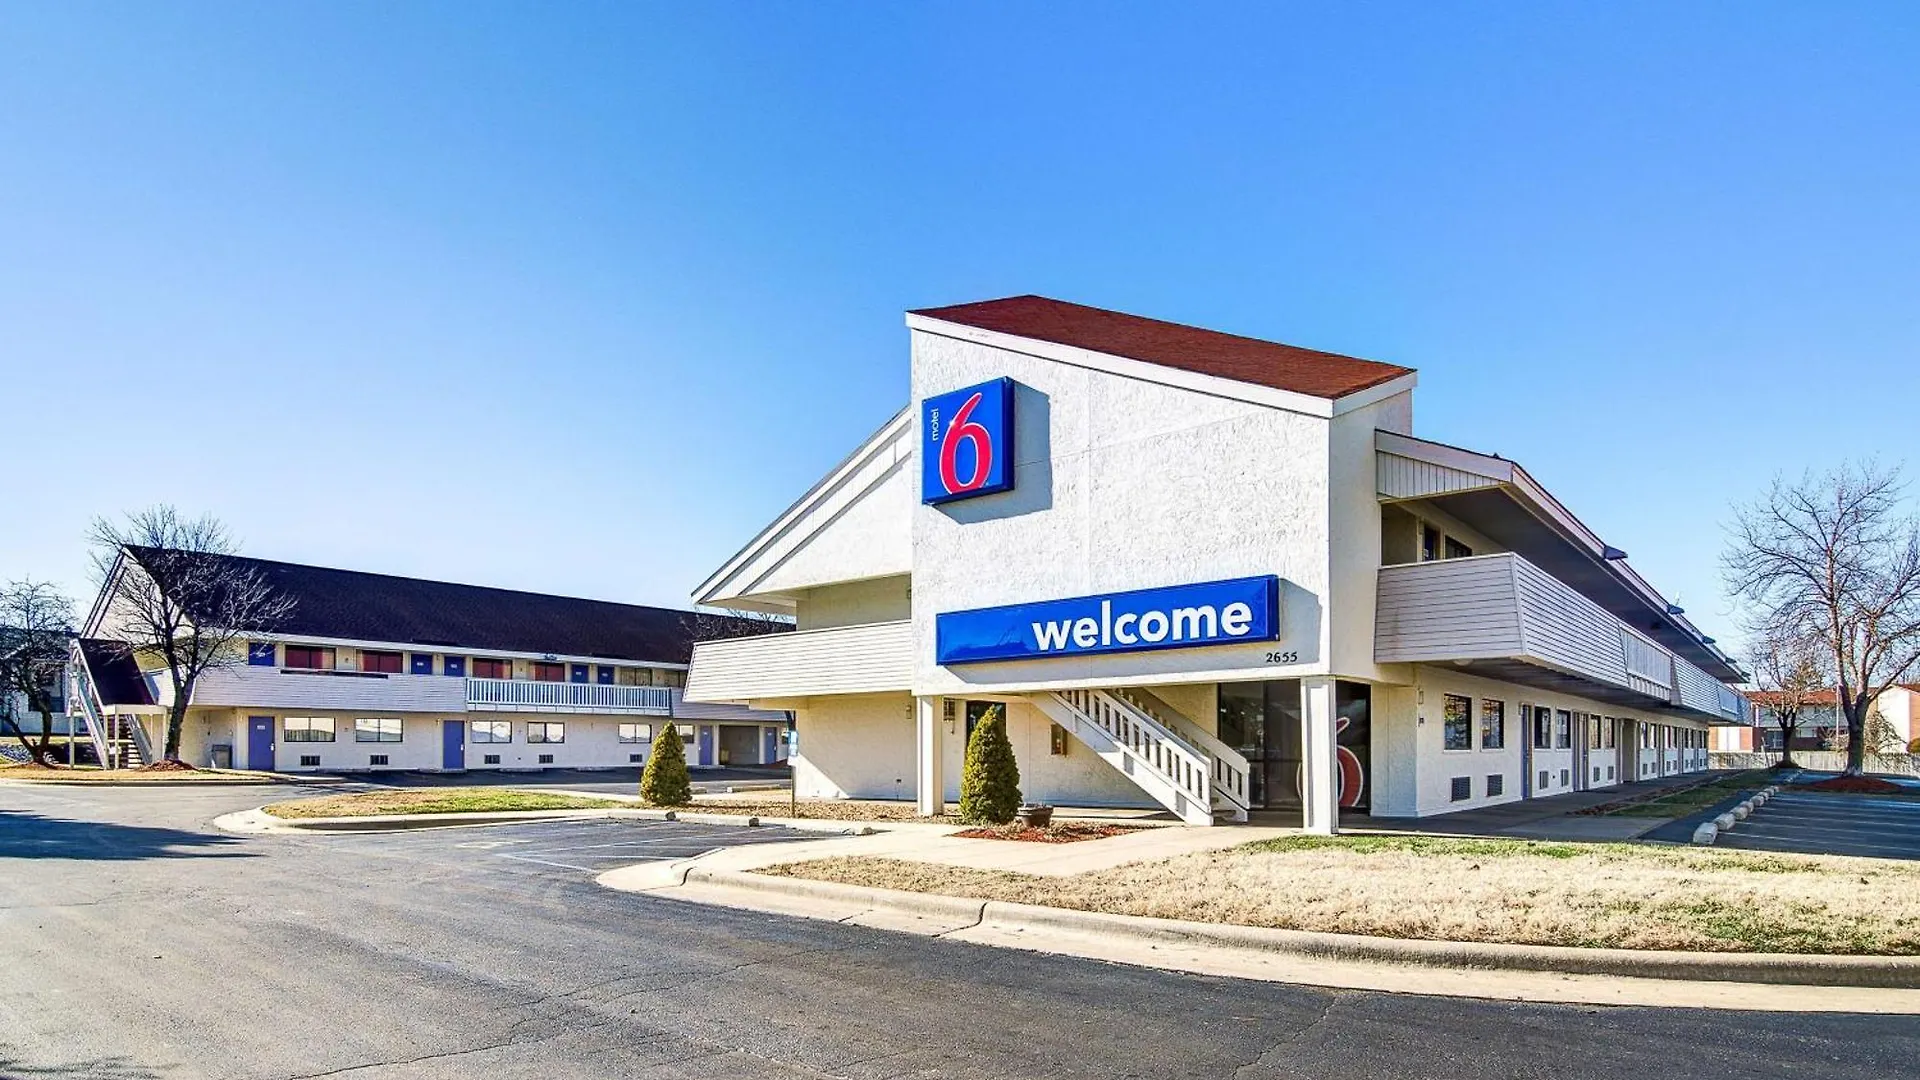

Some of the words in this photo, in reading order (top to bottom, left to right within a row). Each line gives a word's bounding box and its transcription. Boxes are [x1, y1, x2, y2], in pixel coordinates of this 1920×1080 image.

[930, 407, 939, 441] motel
[940, 392, 993, 495] 6
[1032, 600, 1252, 651] welcome
[1266, 651, 1298, 663] 2655
